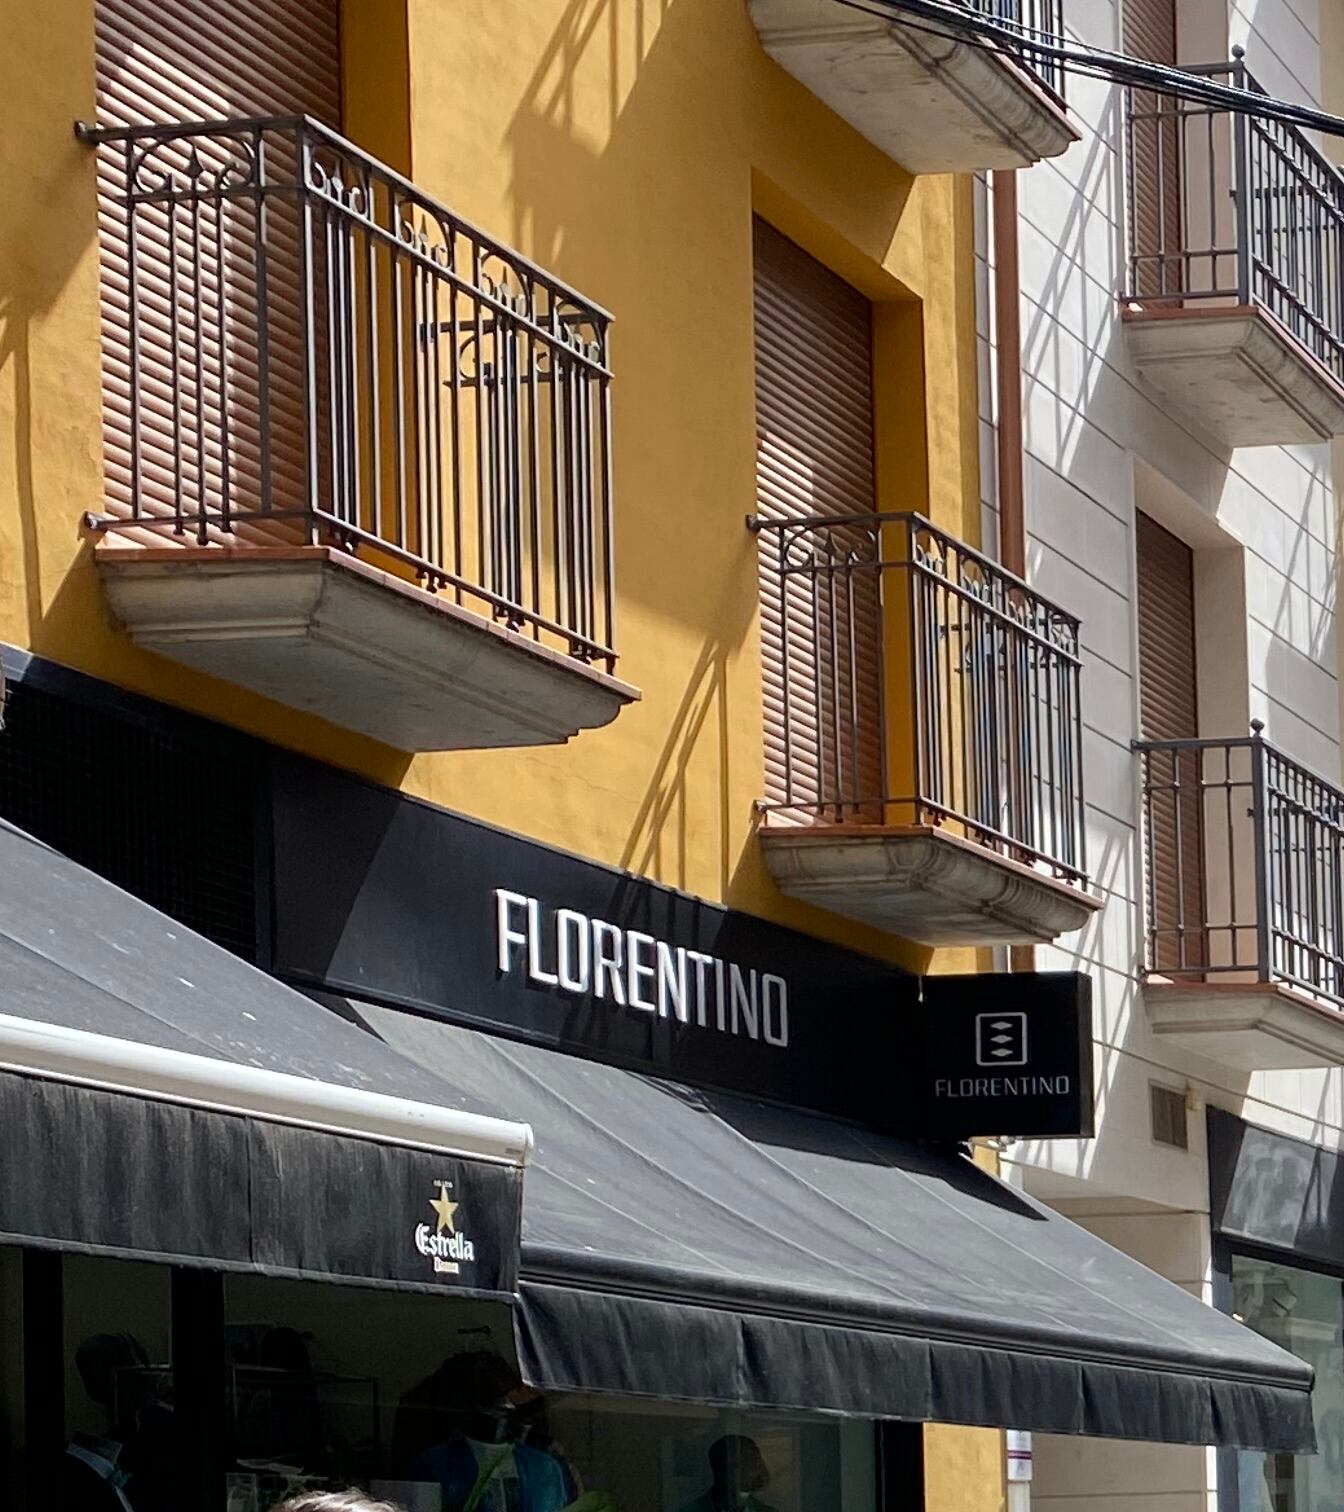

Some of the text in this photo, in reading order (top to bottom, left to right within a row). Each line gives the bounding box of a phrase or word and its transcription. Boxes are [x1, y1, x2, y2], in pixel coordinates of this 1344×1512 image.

[496, 889, 789, 1047] FLORENTINO
[934, 1075, 1071, 1098] FLORENTINO
[414, 1223, 475, 1262] Estrella
